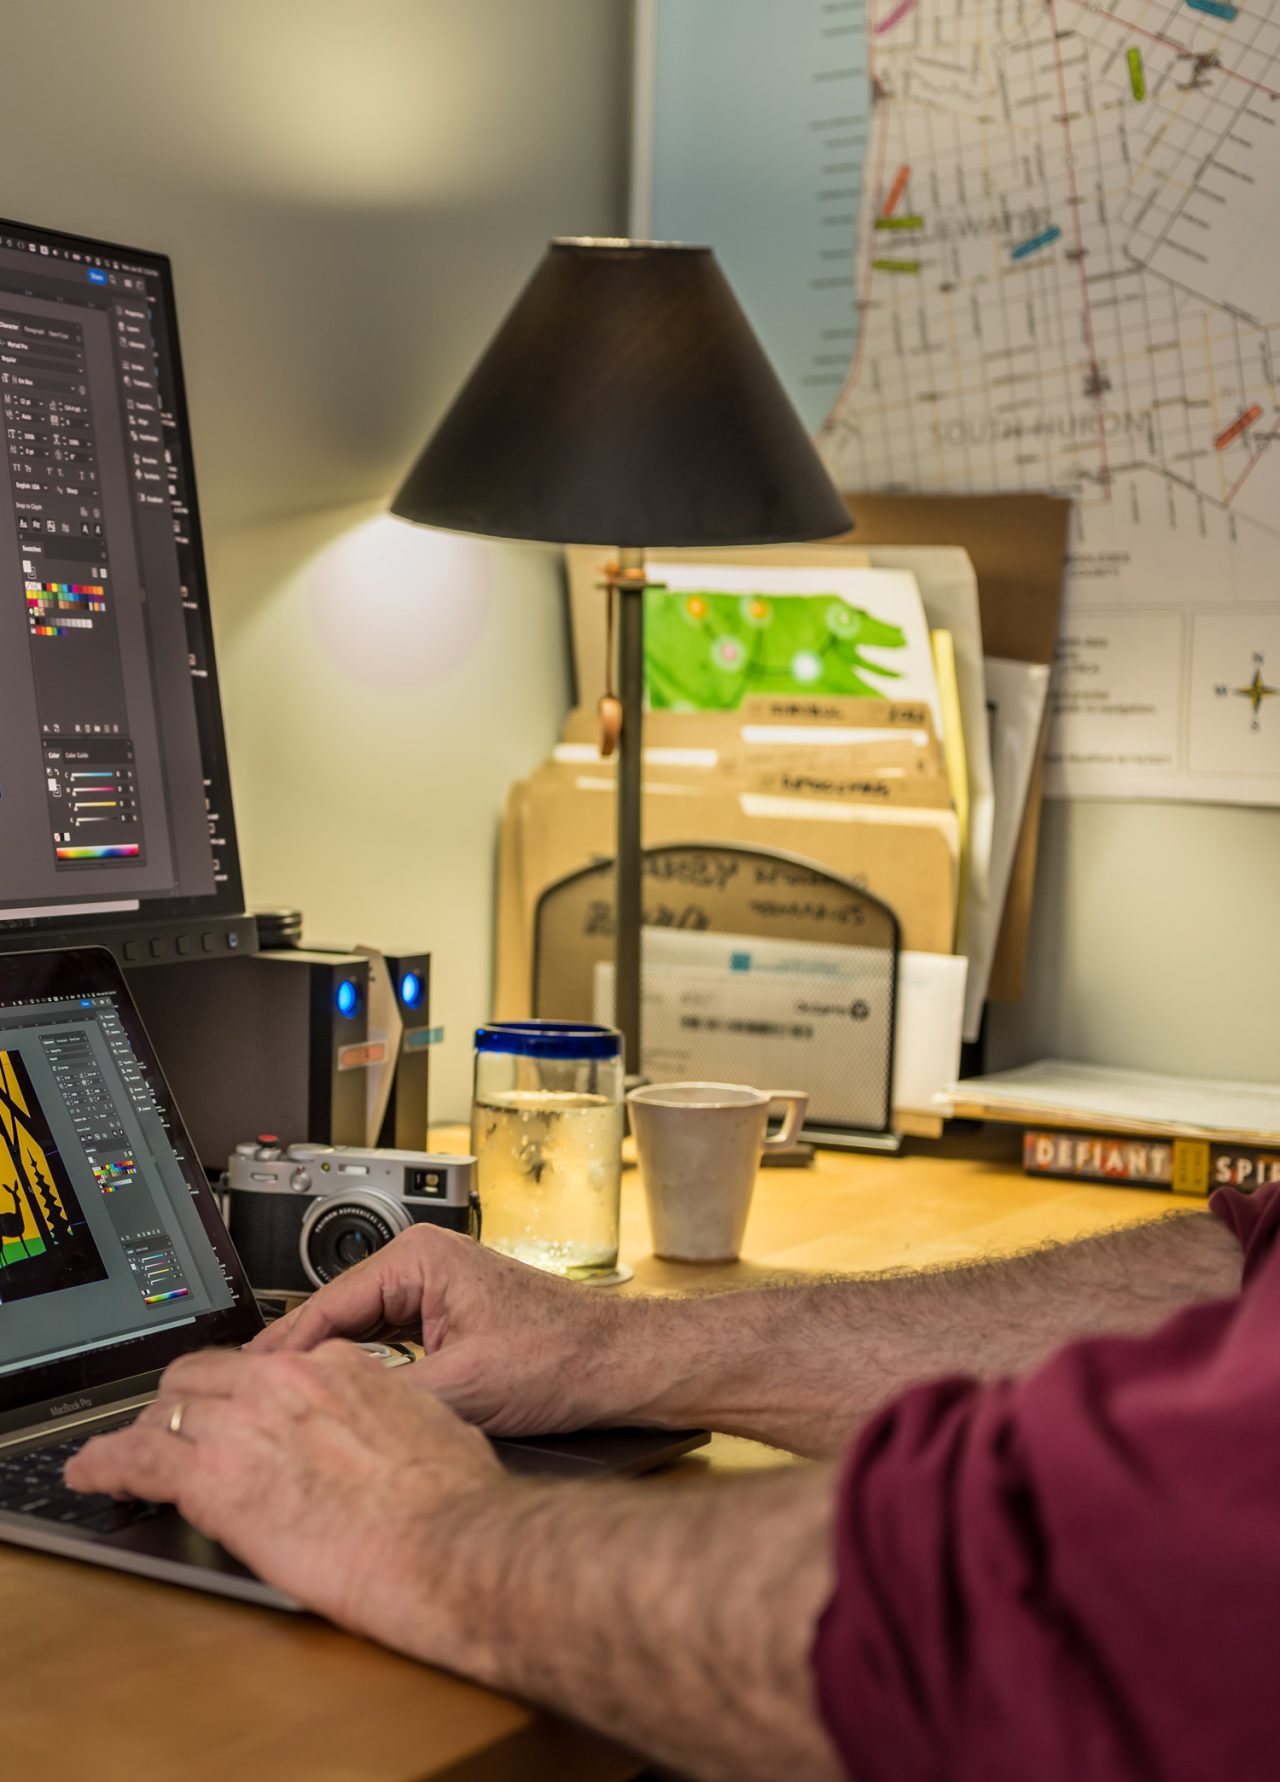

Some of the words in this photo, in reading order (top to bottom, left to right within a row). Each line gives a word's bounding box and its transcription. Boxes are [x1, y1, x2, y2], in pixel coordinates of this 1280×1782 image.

[1034, 1134, 1167, 1176] DEFIANT
[50, 1401, 80, 1416] MacBook
[80, 1398, 93, 1407] Pro
